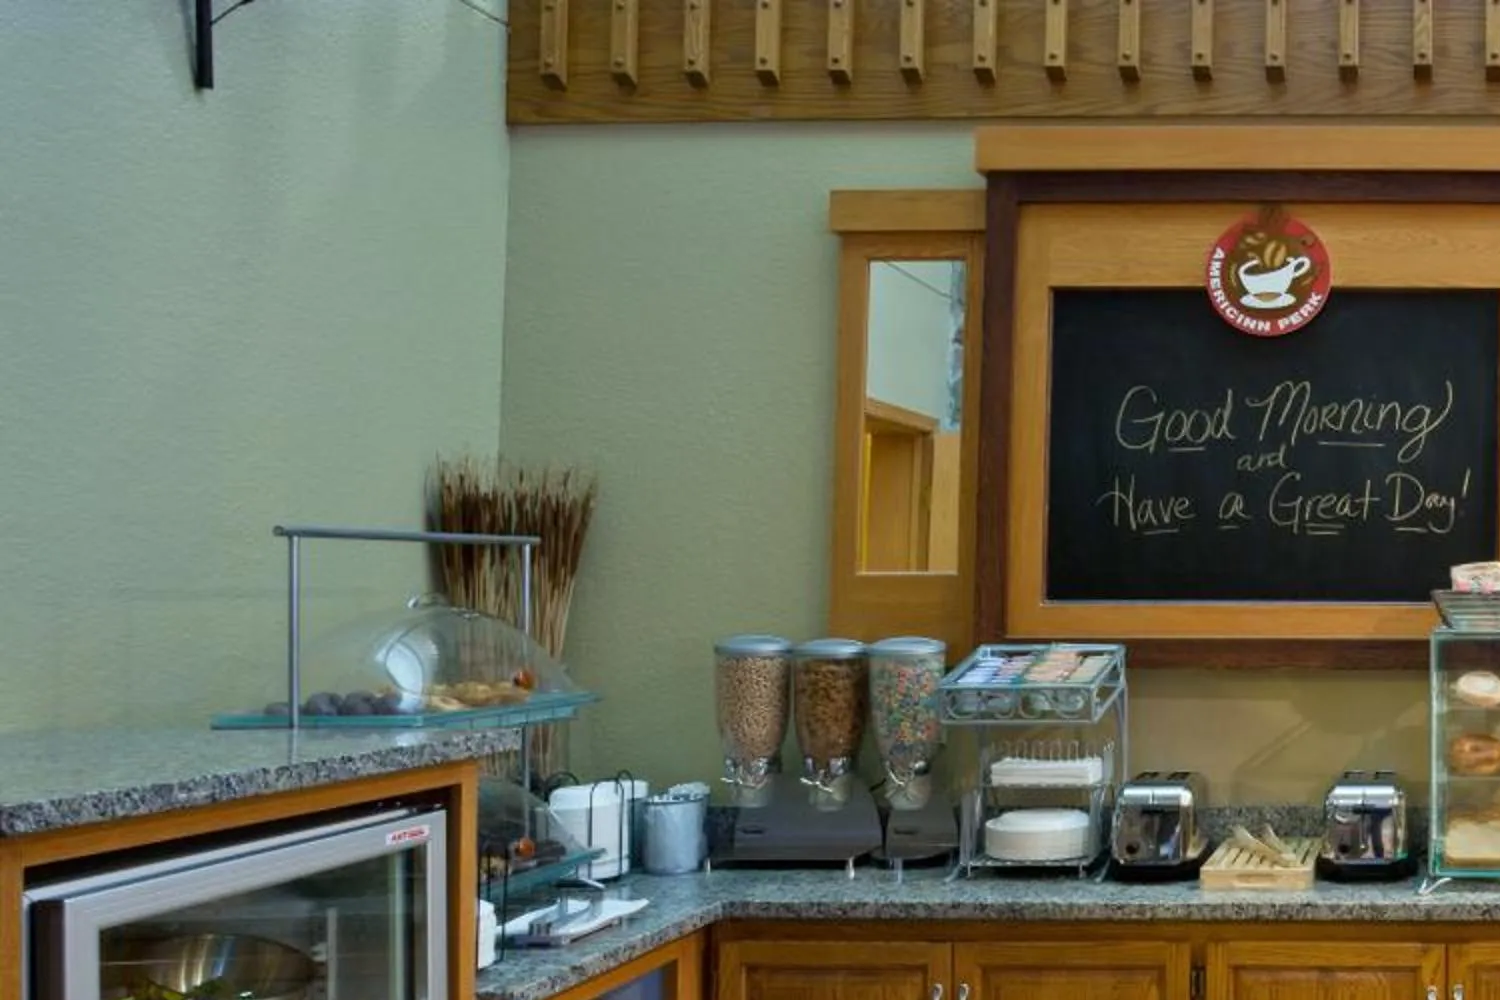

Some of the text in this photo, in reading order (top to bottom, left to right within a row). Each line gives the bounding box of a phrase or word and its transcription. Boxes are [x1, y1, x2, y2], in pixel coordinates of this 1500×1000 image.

[1209, 247, 1322, 331] AMERICINN PERK
[1115, 380, 1454, 464] Good Morning
[1236, 443, 1288, 472] and
[1096, 467, 1472, 535] Have a Great Day!
